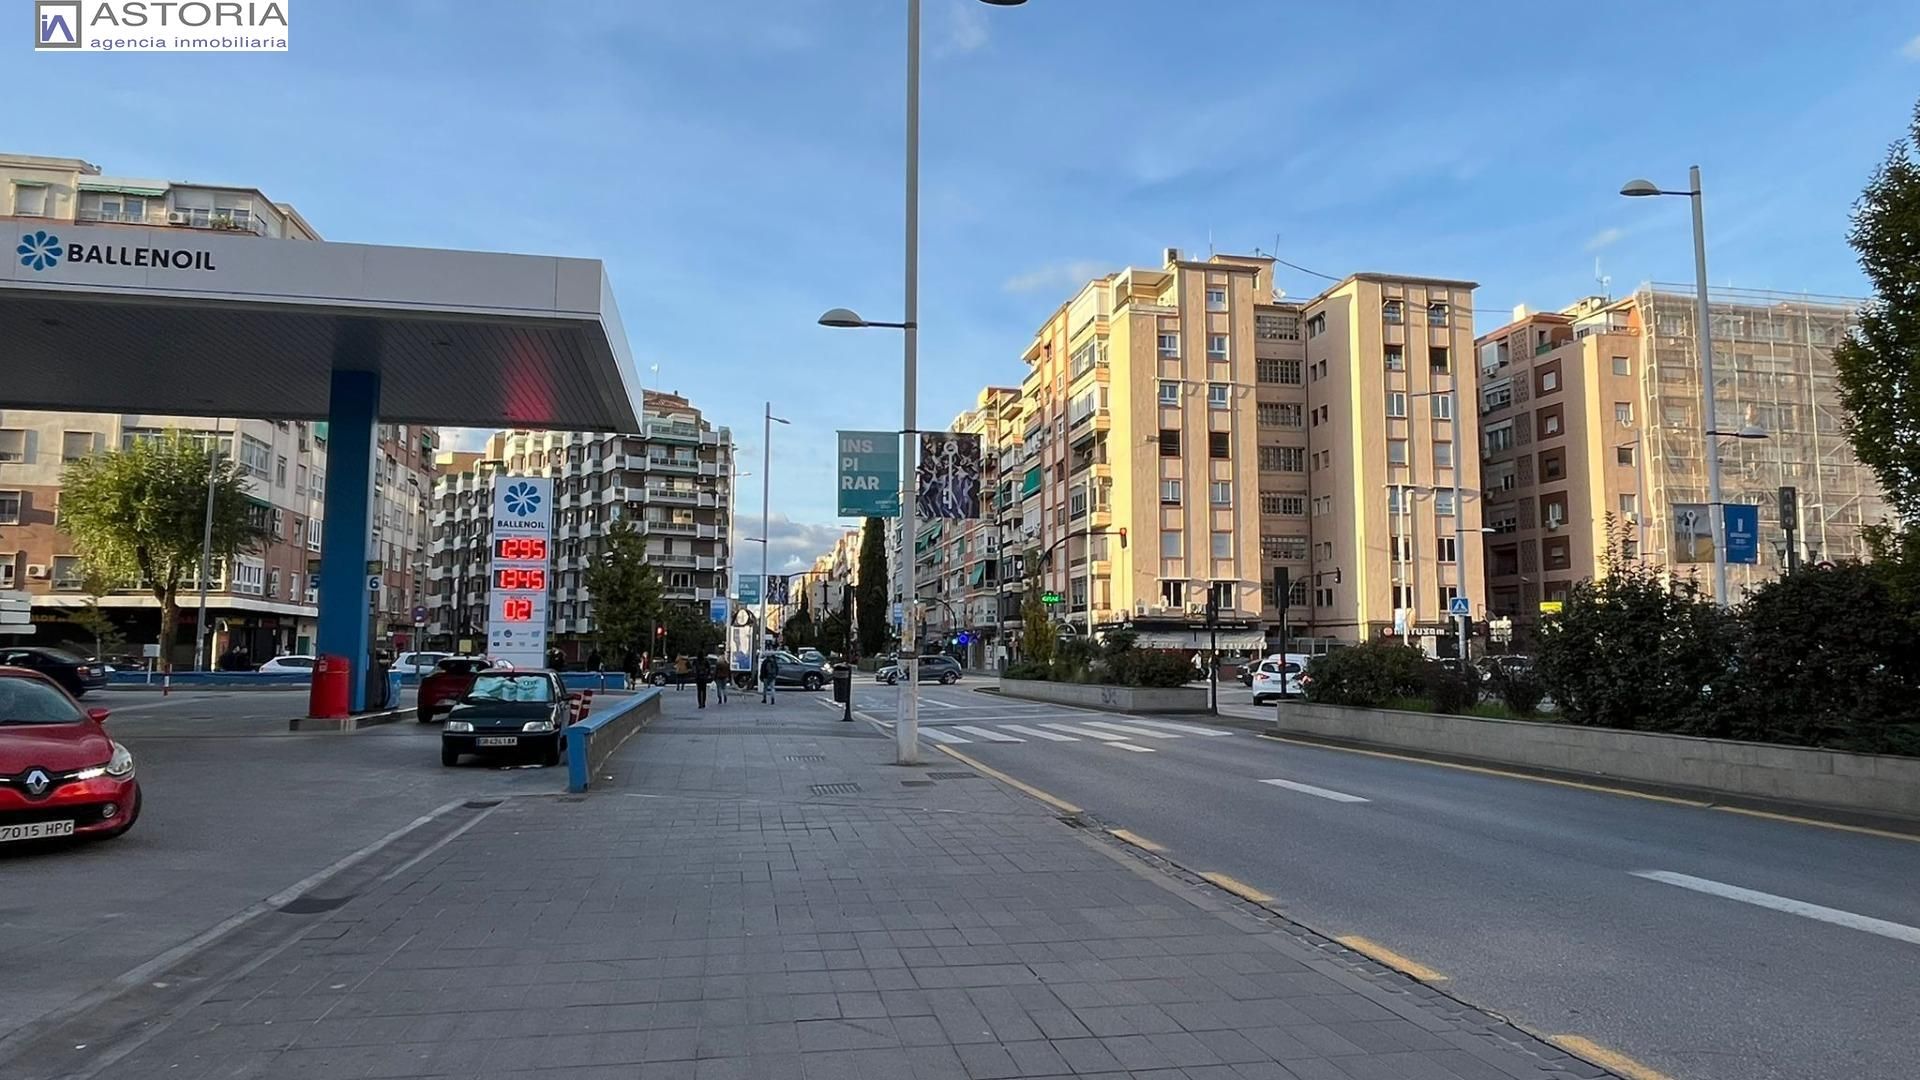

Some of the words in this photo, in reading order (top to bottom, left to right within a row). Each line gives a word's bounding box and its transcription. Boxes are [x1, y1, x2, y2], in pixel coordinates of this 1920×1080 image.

[67, 243, 216, 271] BALLENOIL
[842, 439, 873, 453] INS
[842, 457, 859, 471] PI
[841, 475, 880, 490] RAR
[497, 520, 545, 529] BALLENOIL
[369, 576, 379, 589] 6
[1, 825, 40, 839] 7015
[45, 822, 72, 834] HPG
